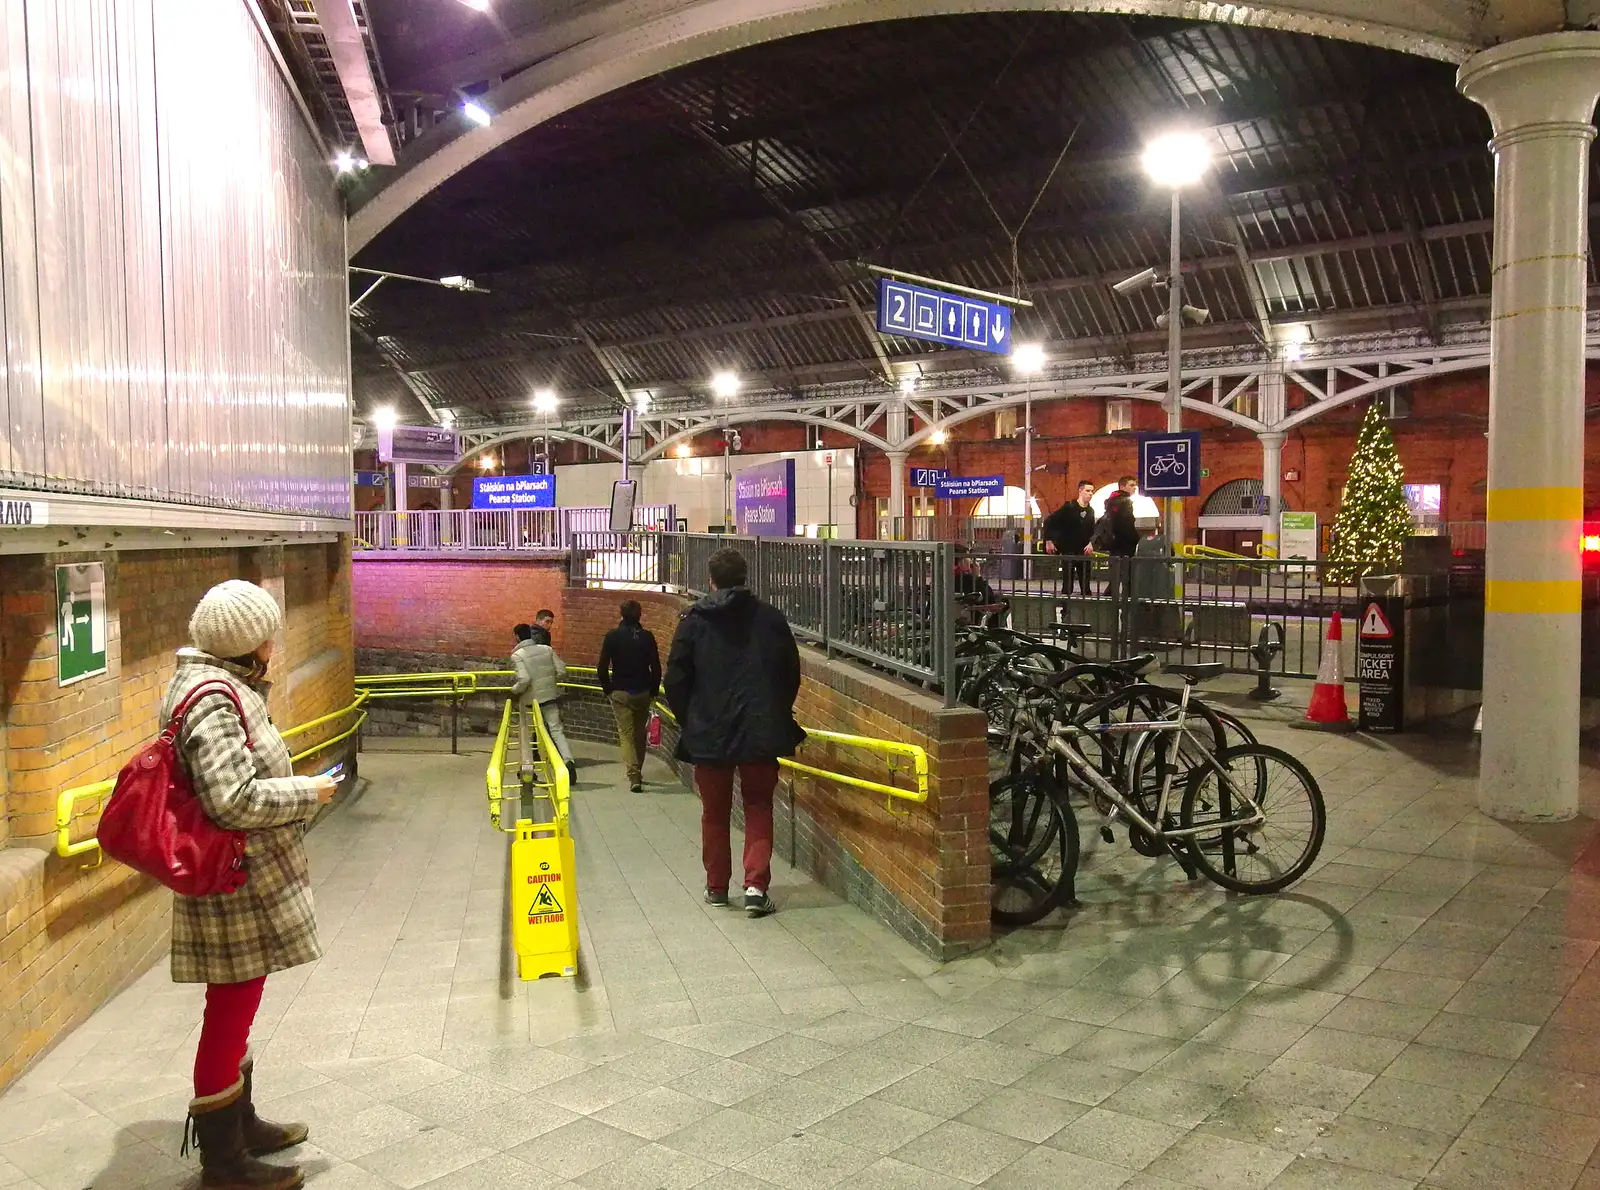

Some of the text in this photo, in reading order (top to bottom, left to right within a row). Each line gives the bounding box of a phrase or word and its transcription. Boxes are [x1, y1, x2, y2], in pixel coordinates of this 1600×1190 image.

[894, 295, 905, 322] 2
[535, 464, 541, 474] 2
[931, 472, 936, 483] 1
[971, 478, 999, 487] bPiarsach
[480, 479, 548, 493] Stáisiún na bPiarsach
[754, 483, 760, 498] na
[489, 492, 536, 504] Pearse Station
[744, 503, 776, 523] Pearse Station
[1360, 658, 1394, 669] TICKET
[1361, 669, 1390, 679] AREA
[527, 873, 561, 884] CAUTION
[528, 913, 565, 925] WET FLOOR
